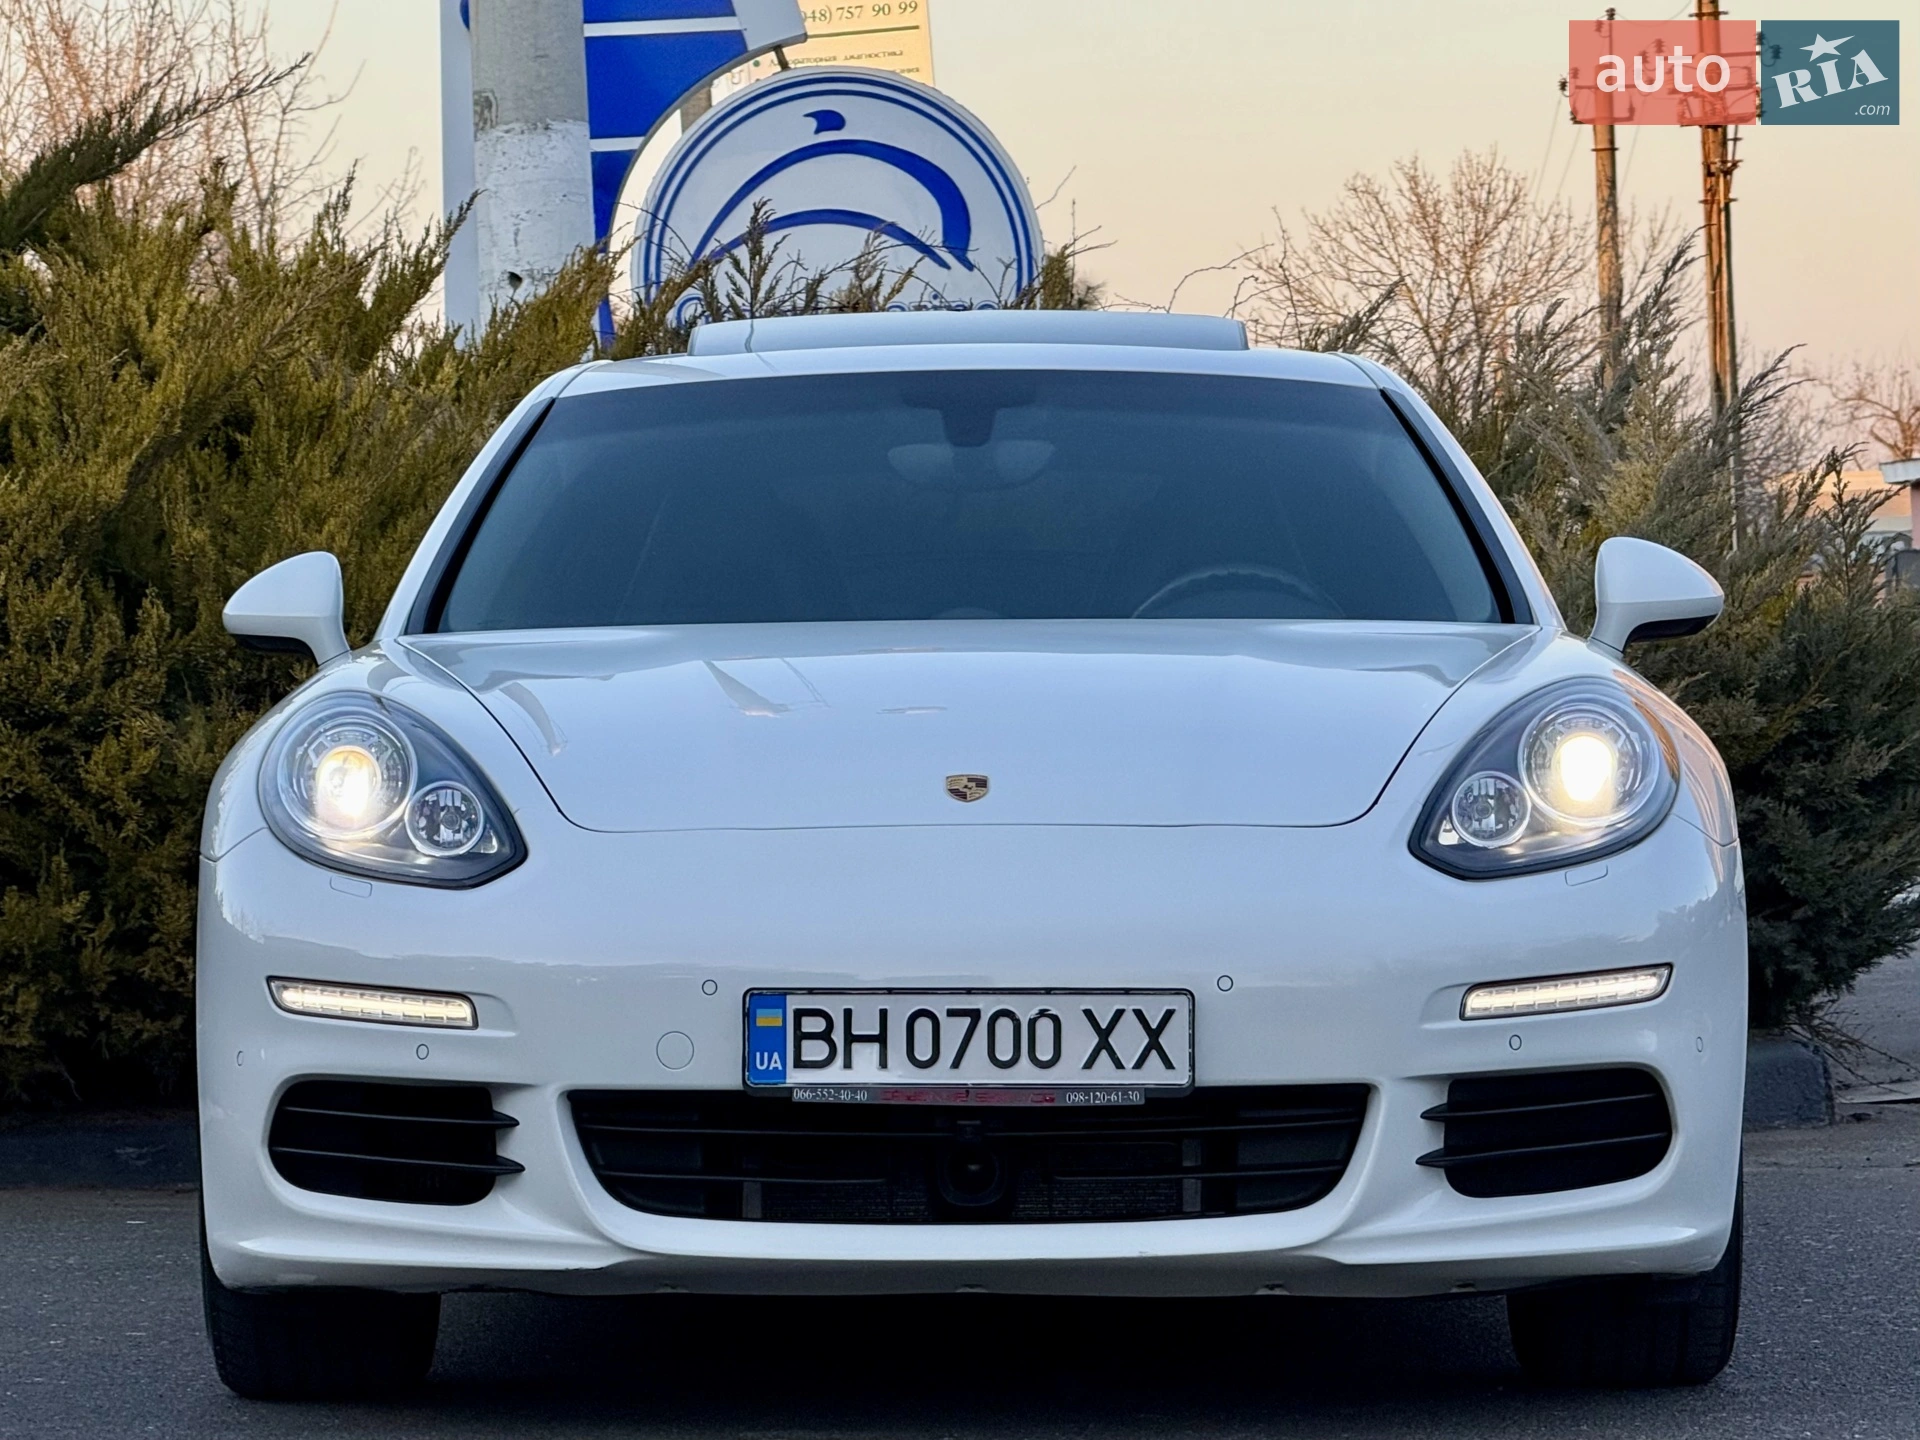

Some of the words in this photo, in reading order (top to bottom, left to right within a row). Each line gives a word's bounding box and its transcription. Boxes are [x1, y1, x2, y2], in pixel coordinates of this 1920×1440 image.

[836, 5, 863, 20] 757
[872, 3, 891, 17] 90
[899, 0, 918, 14] 99
[792, 1007, 888, 1069] BH
[905, 1007, 1062, 1069] 0700
[1081, 1007, 1176, 1070] XX
[755, 1052, 783, 1071] UA
[793, 1088, 868, 1101] 066-552-40-40
[1065, 1091, 1140, 1104] 098-120-61-30
